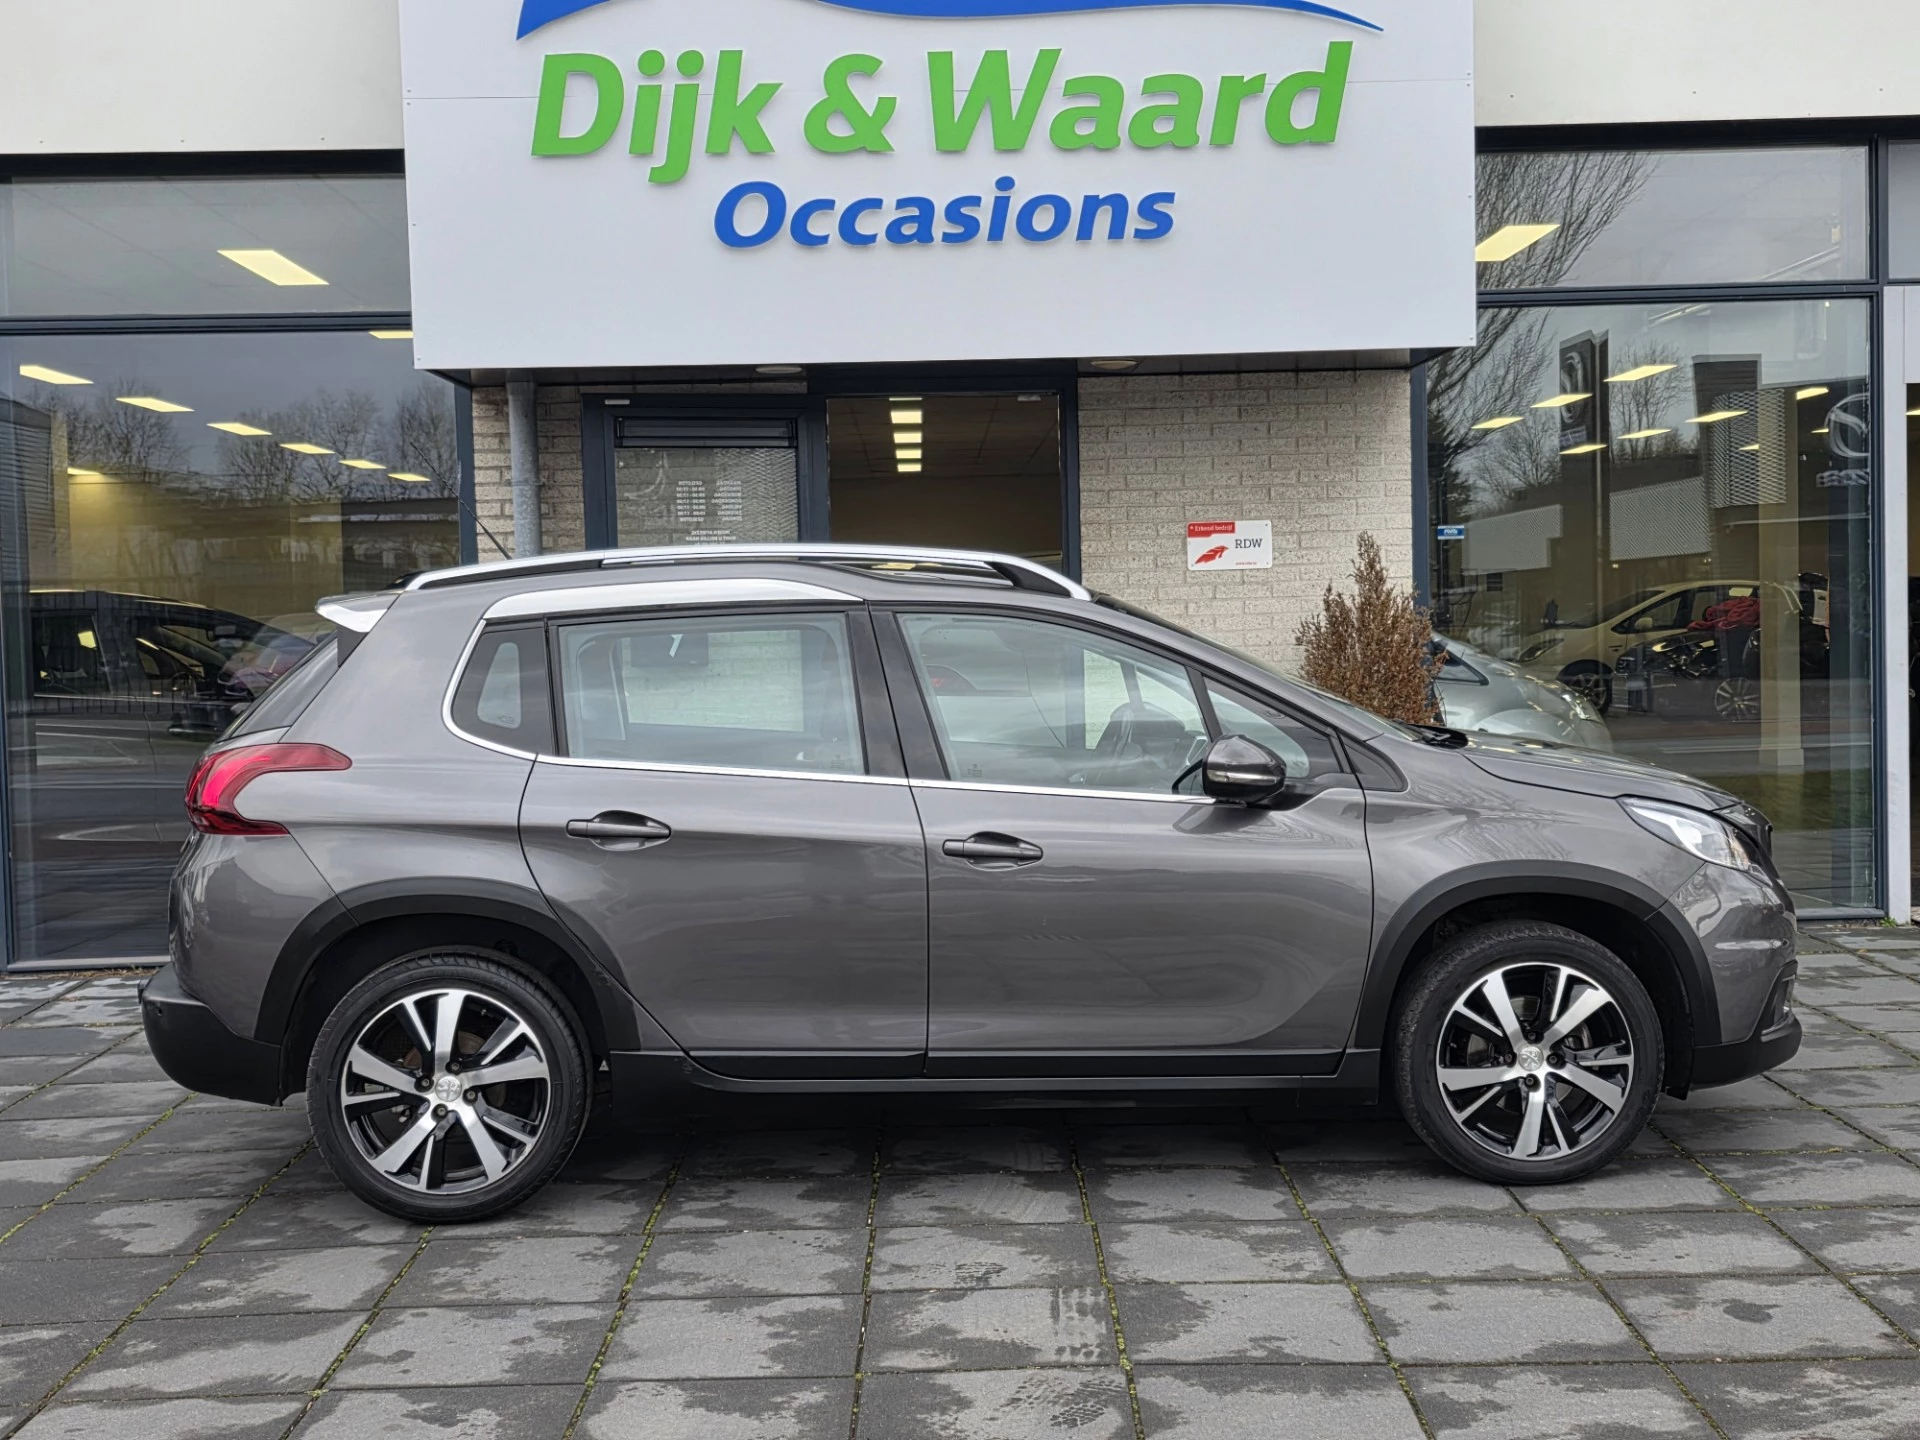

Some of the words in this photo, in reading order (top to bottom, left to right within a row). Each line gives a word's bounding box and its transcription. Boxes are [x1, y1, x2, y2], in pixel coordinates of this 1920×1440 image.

[531, 50, 782, 185] Dijk
[804, 54, 898, 155] &
[928, 41, 1352, 151] Waard
[714, 176, 1175, 249] Occasions
[1235, 538, 1262, 549] RDW
